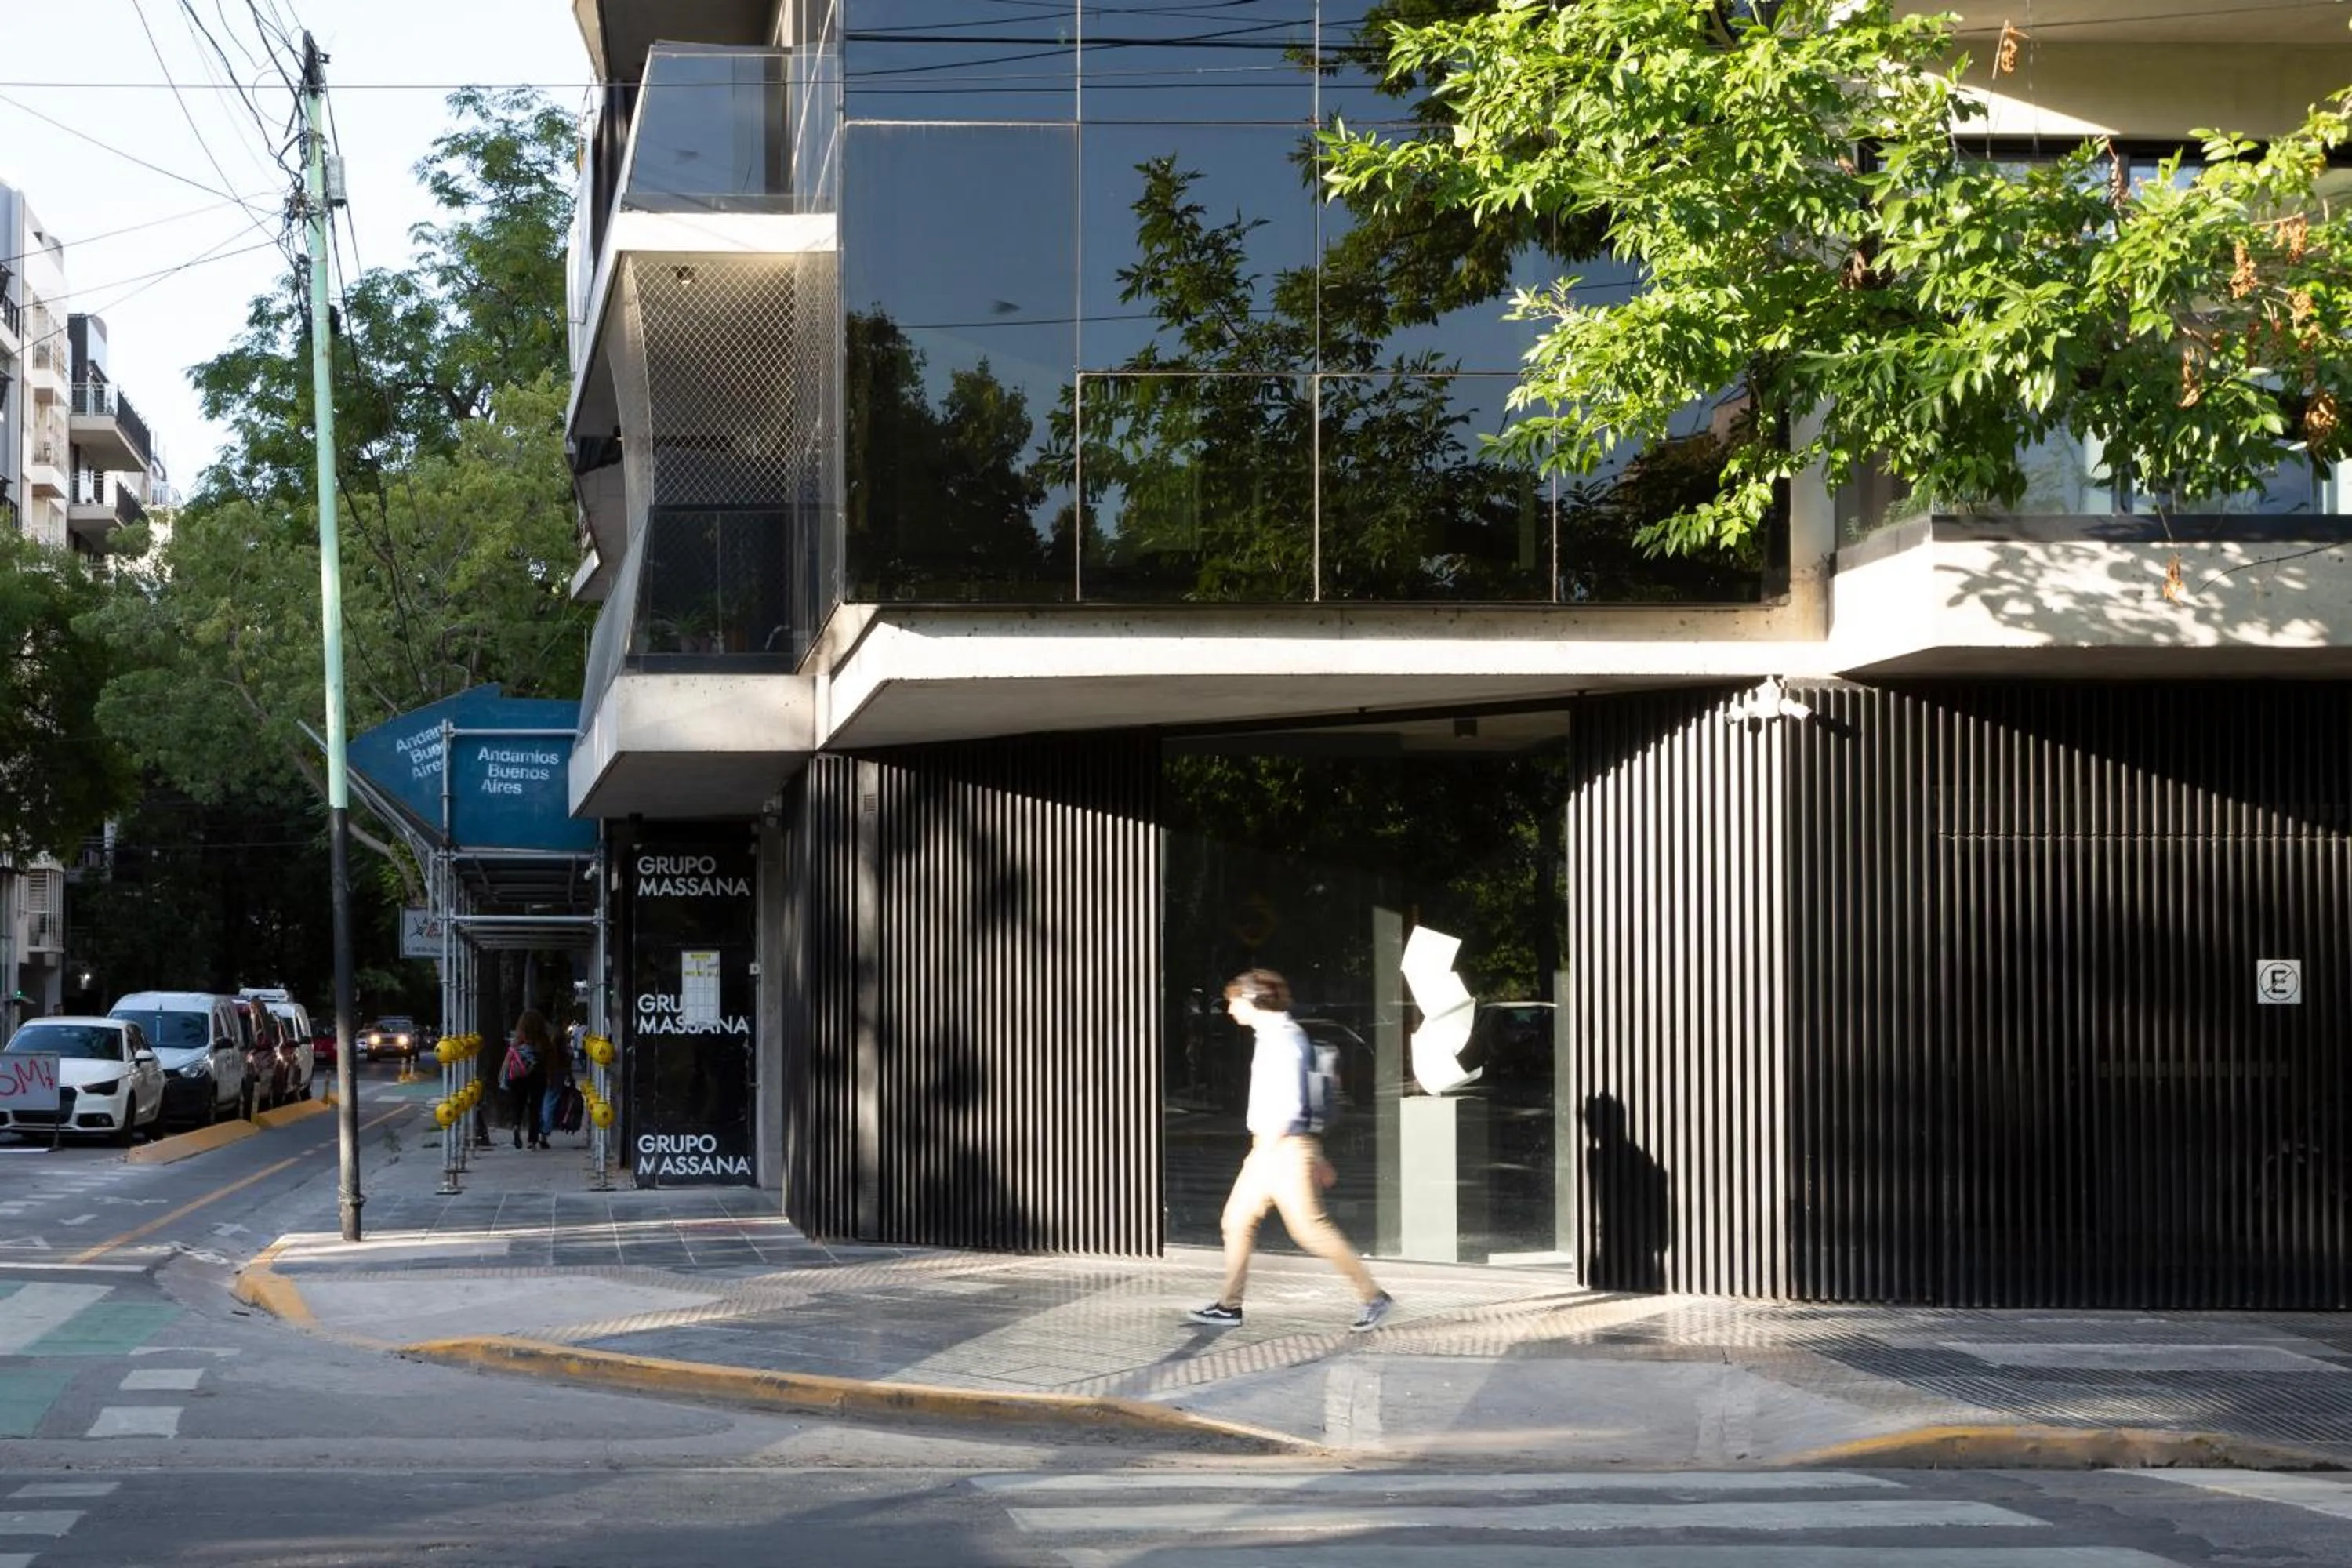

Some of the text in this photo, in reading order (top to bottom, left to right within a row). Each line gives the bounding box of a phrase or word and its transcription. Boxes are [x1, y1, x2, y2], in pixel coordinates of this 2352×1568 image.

[396, 725, 442, 753] Andam
[410, 741, 443, 764] Bue
[477, 746, 559, 765] Andamios
[488, 763, 550, 780] Buenos
[481, 779, 522, 794] Aires
[637, 856, 716, 875] GRUPO
[637, 877, 750, 896] MASSANA
[2271, 970, 2287, 993] E
[637, 993, 682, 1013] GRU
[637, 1134, 717, 1153] GRUPO
[637, 1156, 751, 1175] MASSANA
